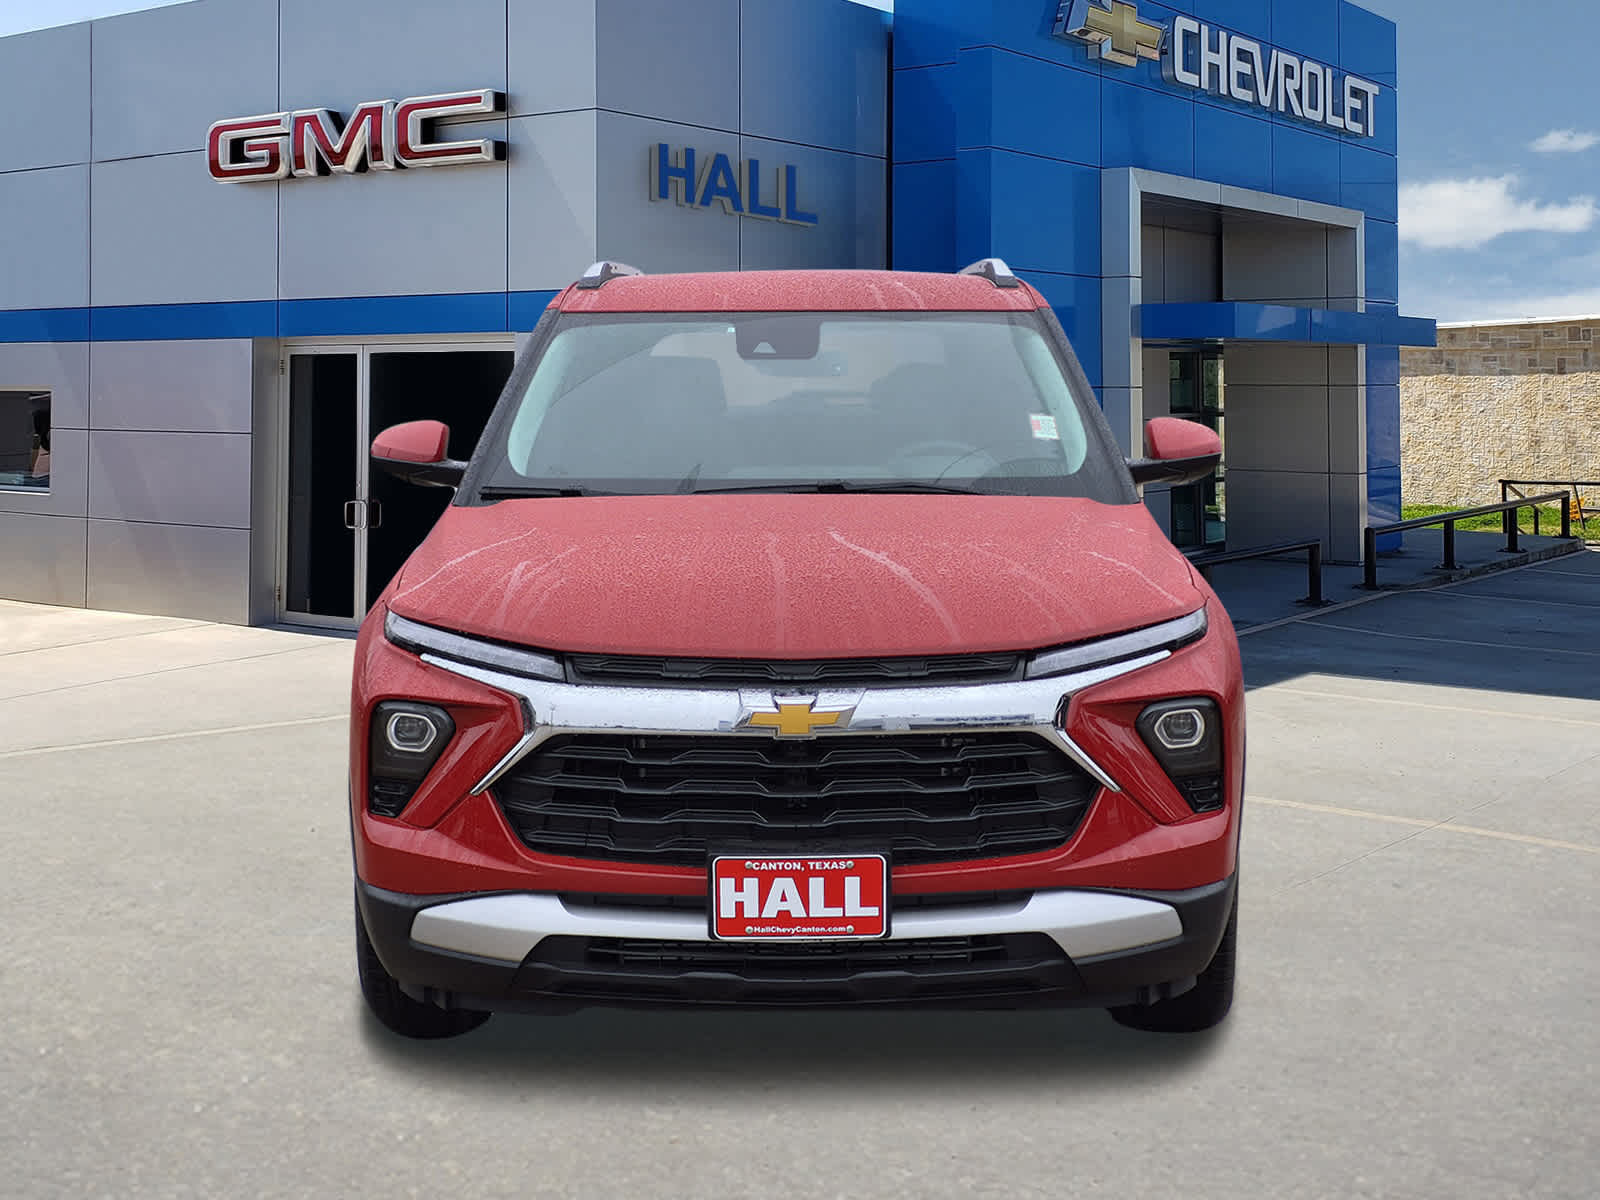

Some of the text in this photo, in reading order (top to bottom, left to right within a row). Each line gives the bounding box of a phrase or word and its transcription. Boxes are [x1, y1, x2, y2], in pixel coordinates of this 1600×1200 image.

[1173, 15, 1380, 137] CHEVROLET
[208, 88, 506, 184] GMC
[652, 143, 819, 226] HALL
[719, 876, 879, 918] HALL
[752, 861, 847, 871] CANTON, TEXAS
[754, 926, 846, 934] HallChevyCanton.com
